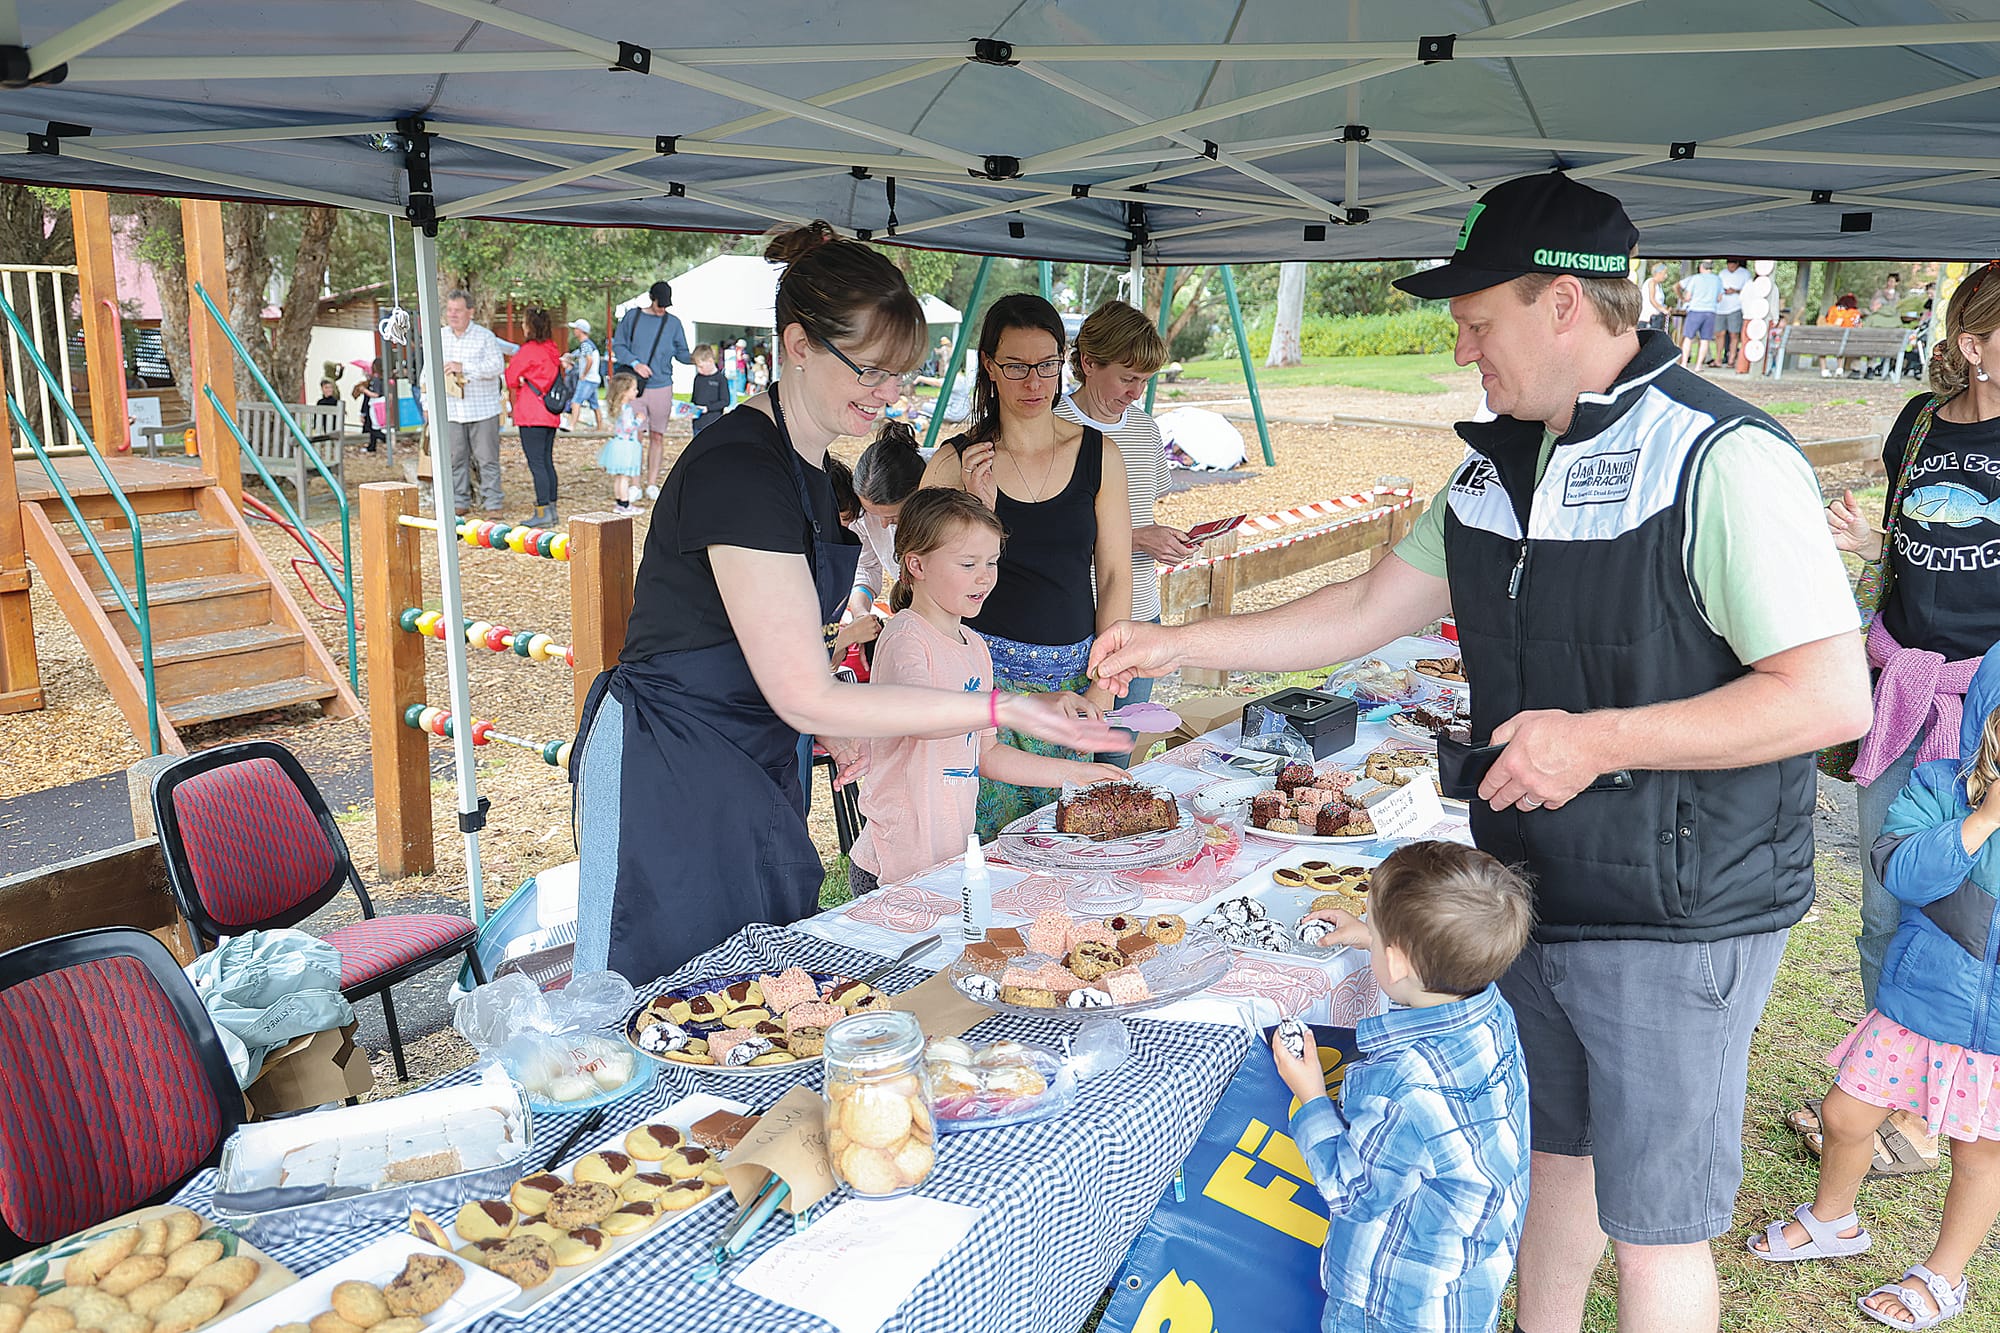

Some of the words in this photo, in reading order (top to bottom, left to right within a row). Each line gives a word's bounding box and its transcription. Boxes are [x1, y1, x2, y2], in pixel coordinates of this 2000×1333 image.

[1533, 248, 1626, 272] QUIKSILVER
[1591, 471, 1633, 488] RACING
[1904, 452, 1959, 489] LUE
[1964, 453, 2000, 480] BO
